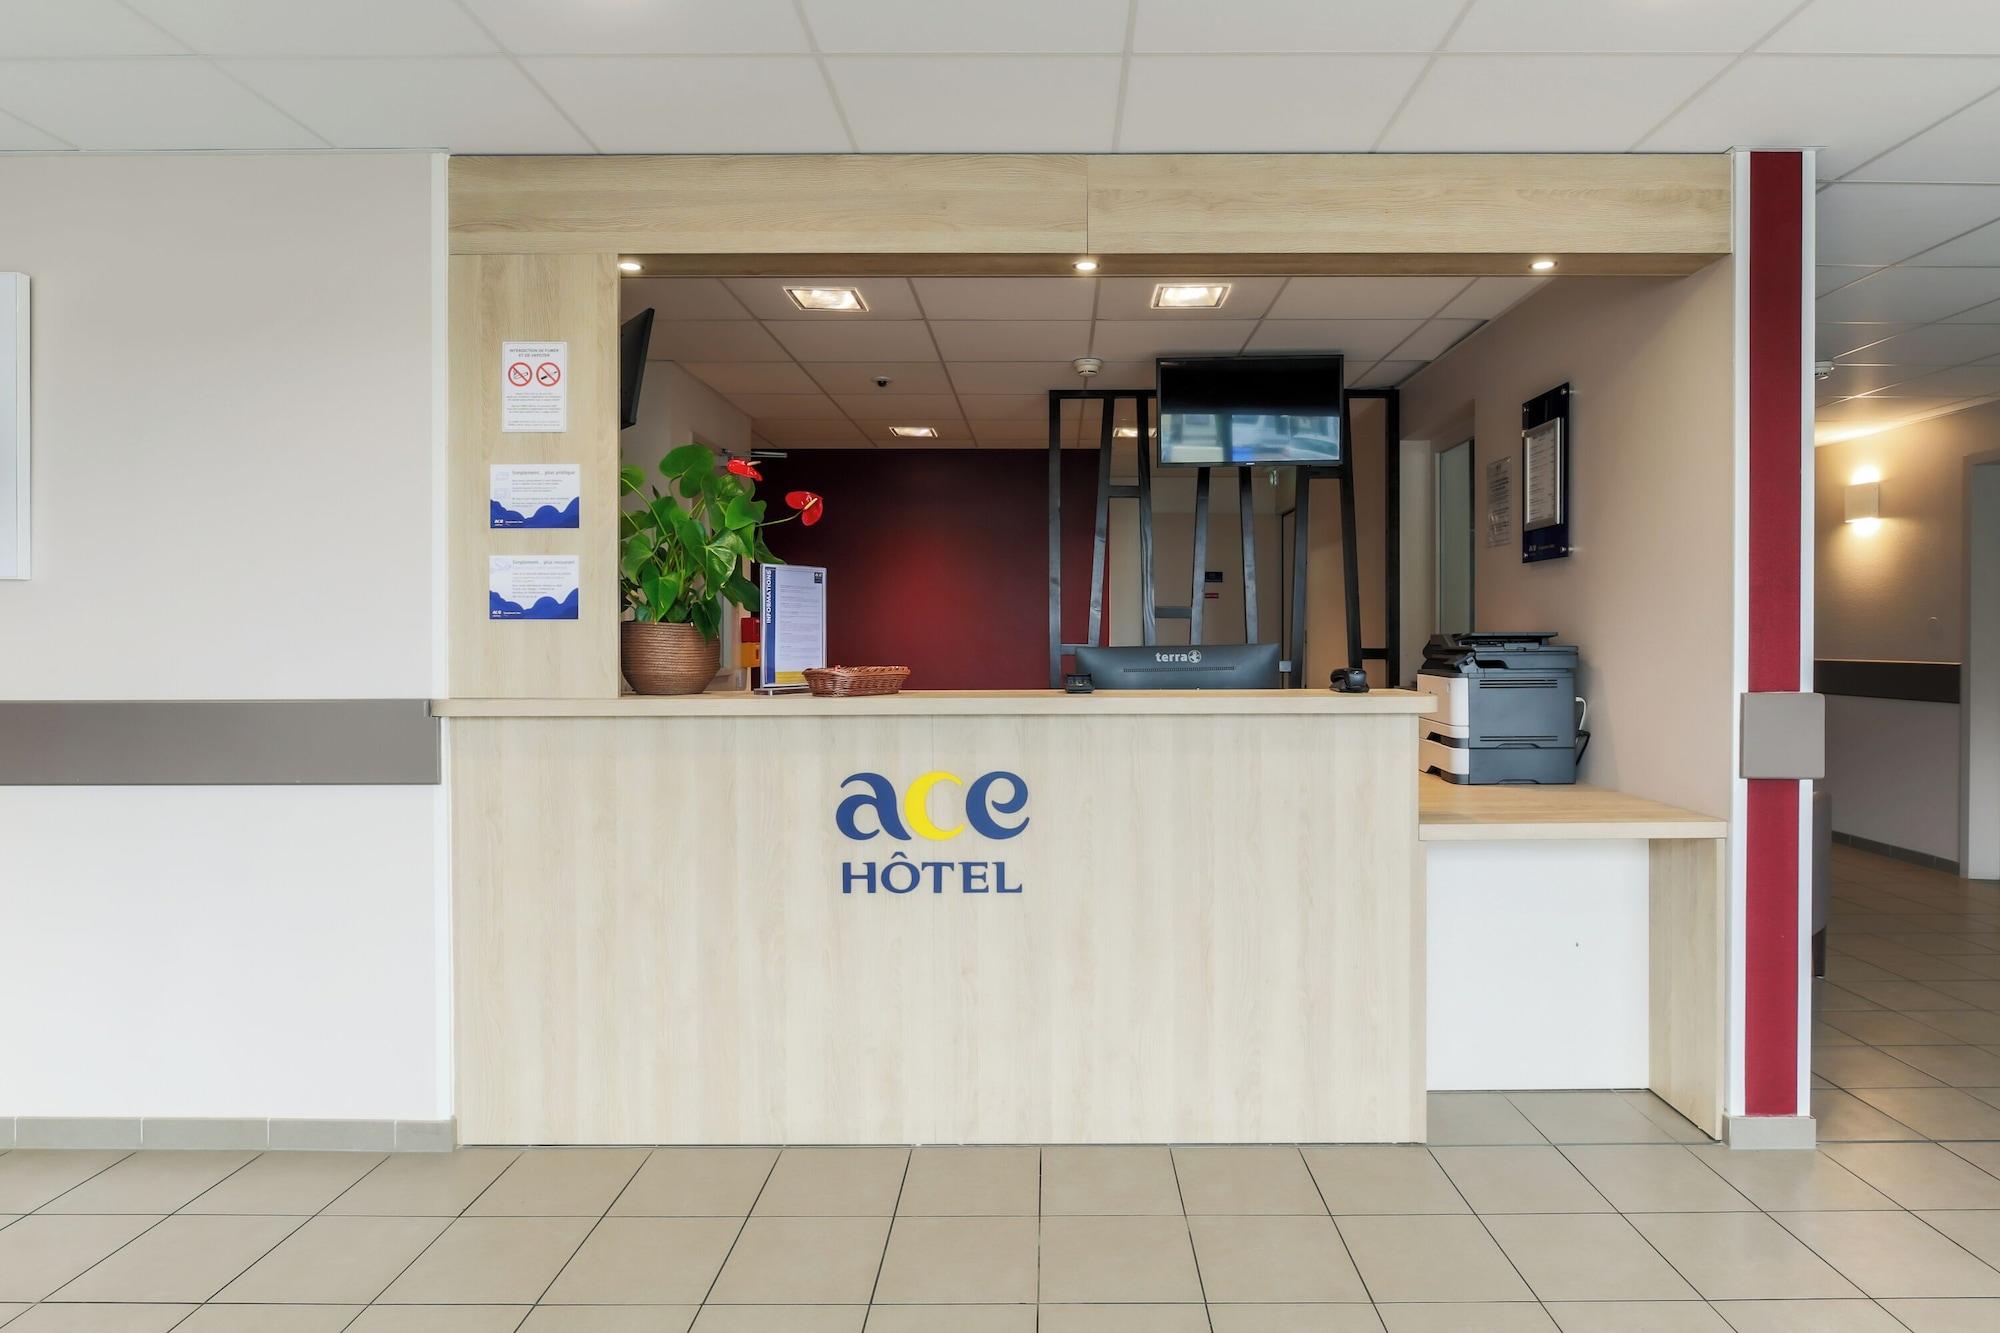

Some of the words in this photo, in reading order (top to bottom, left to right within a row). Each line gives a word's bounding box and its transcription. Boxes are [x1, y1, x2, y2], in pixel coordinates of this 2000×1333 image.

[1155, 652, 1188, 662] terra
[836, 770, 1030, 841] ace
[842, 851, 1023, 894] HÔTEL
